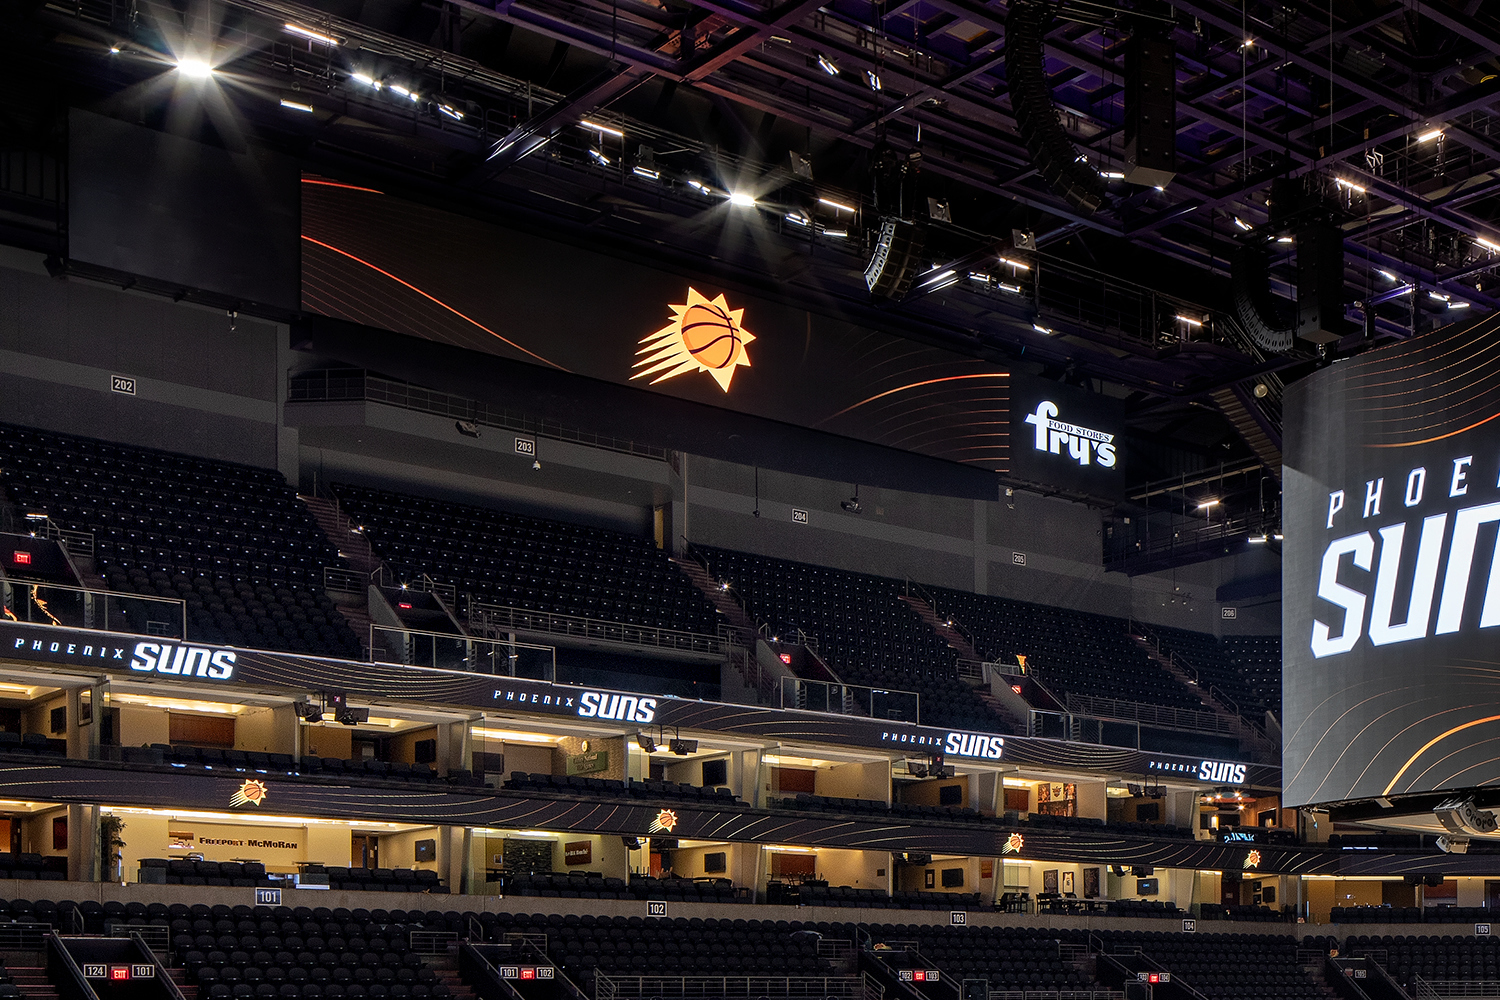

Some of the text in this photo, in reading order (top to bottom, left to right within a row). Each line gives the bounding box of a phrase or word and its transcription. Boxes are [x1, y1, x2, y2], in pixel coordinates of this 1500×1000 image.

[114, 379, 133, 393] 202
[1024, 400, 1116, 467] fry's
[1049, 421, 1110, 442] FOOD STORES
[517, 442, 532, 453] 203
[15, 638, 236, 679] PHOENIX SUNS
[494, 690, 657, 723] PHOENIX SUNS
[882, 732, 1004, 759] PHOENIX SUNS
[1150, 761, 1246, 783] PHOENIX SUNS
[260, 892, 278, 903] 101
[650, 903, 664, 914] 102
[87, 966, 103, 976] 124
[136, 966, 150, 976] 101
